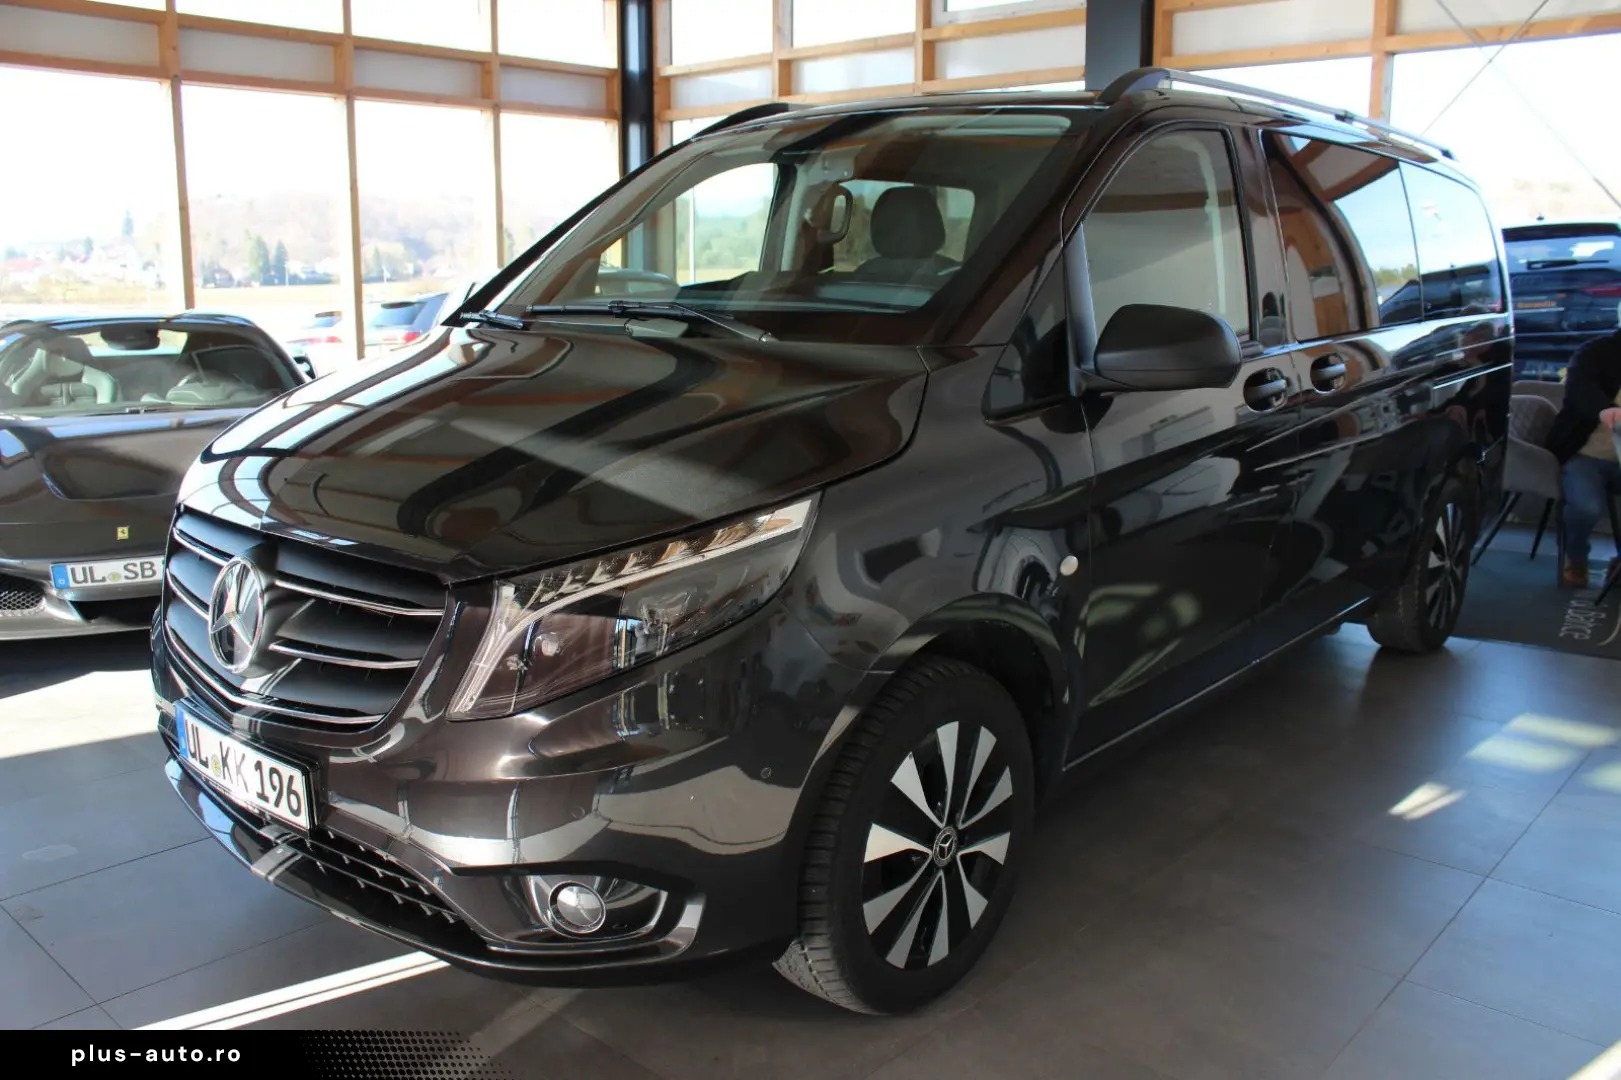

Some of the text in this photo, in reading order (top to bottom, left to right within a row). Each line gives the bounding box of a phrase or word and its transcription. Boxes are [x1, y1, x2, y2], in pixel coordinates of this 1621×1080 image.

[70, 560, 157, 585] UL SB
[184, 719, 302, 818] UL KK 196
